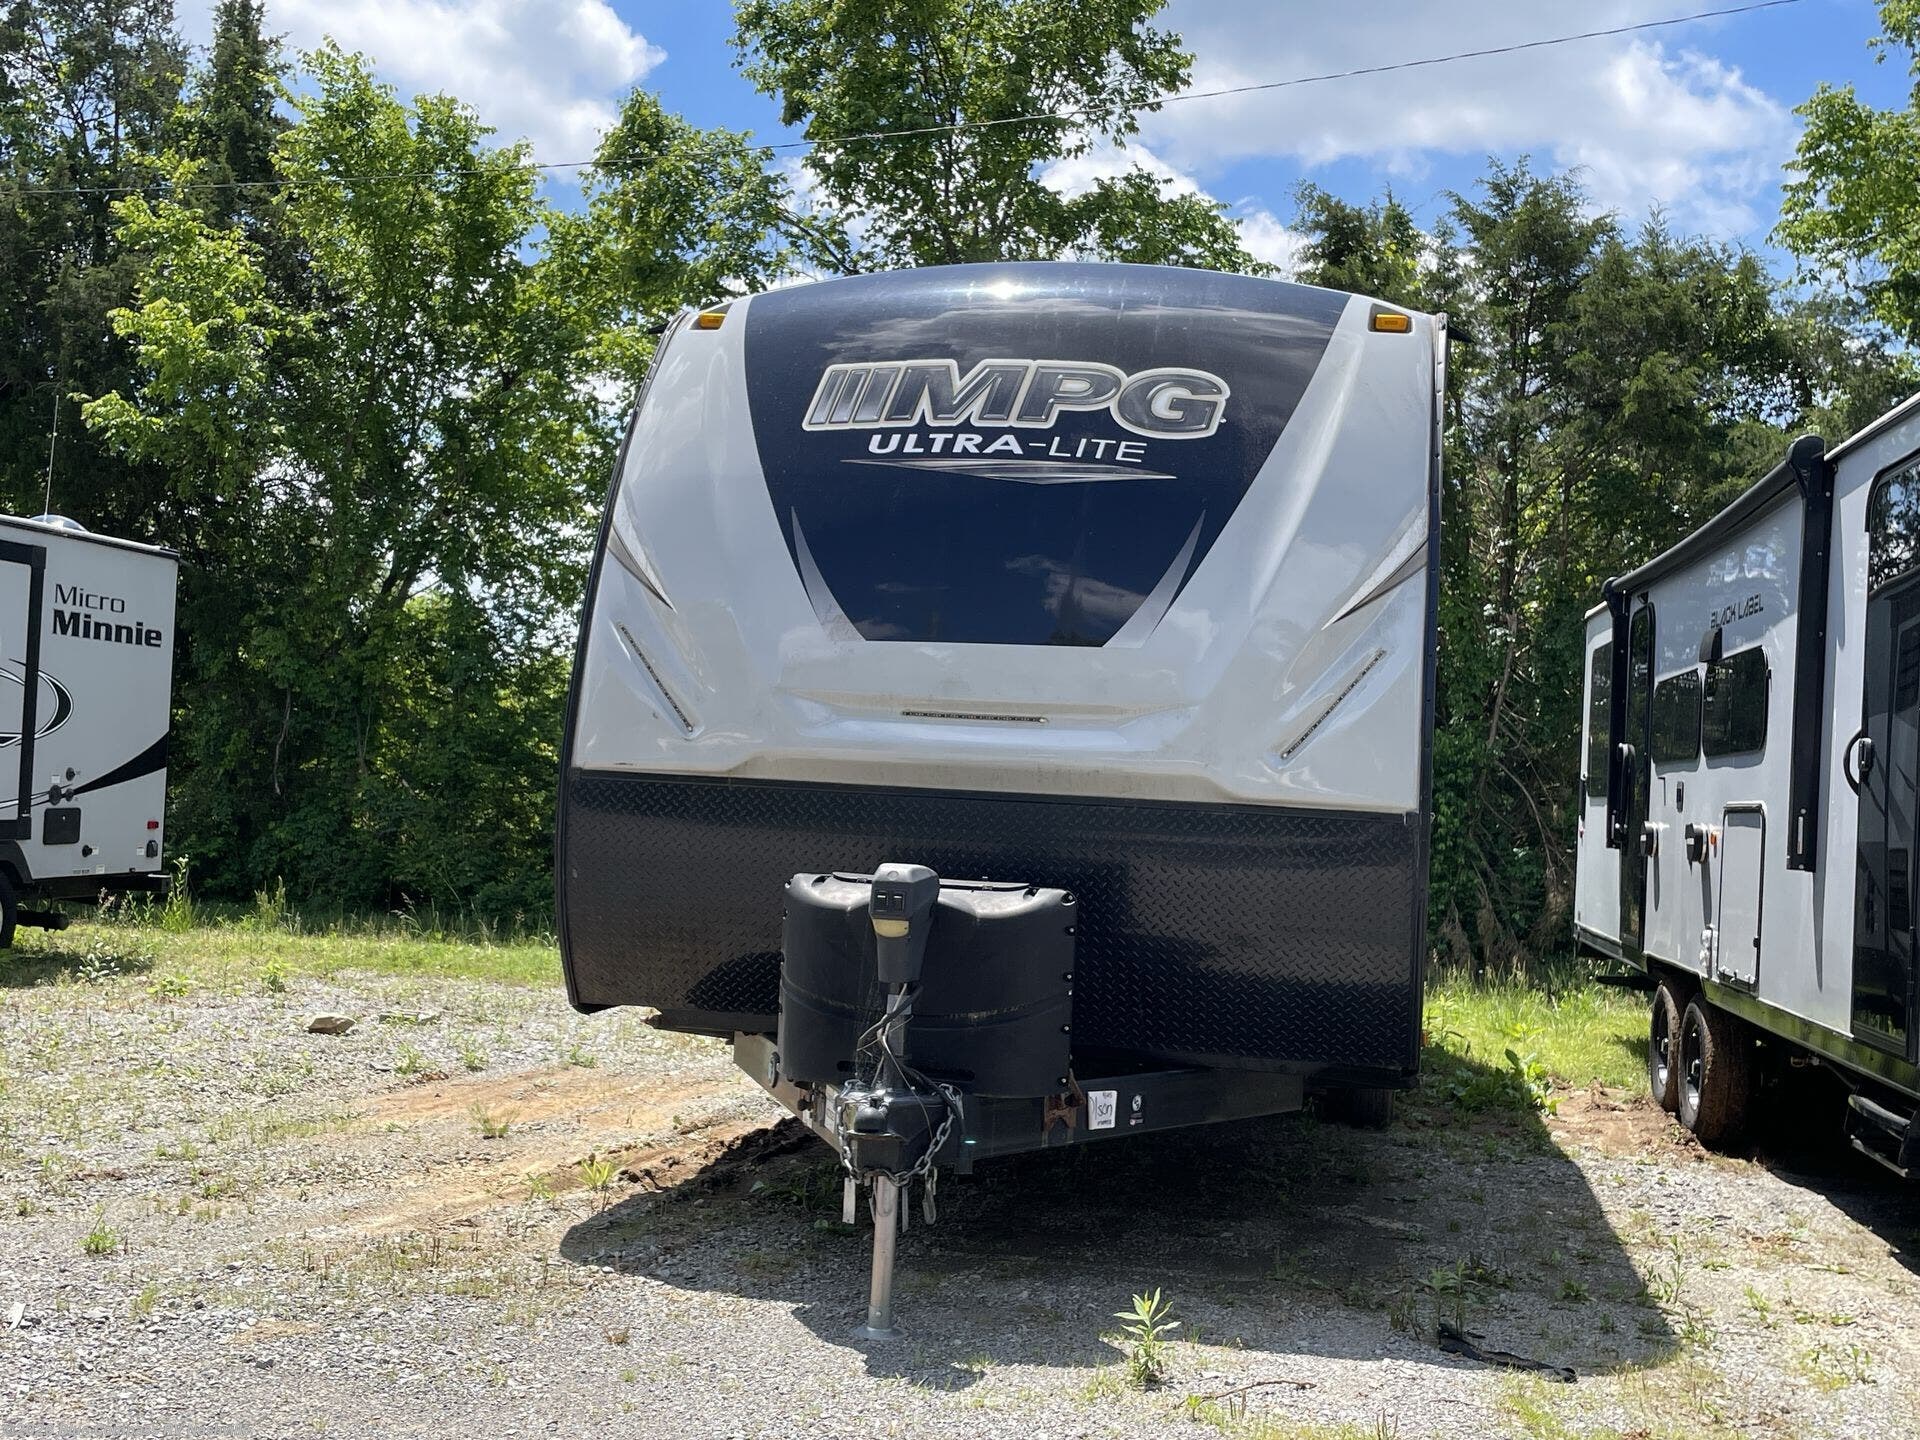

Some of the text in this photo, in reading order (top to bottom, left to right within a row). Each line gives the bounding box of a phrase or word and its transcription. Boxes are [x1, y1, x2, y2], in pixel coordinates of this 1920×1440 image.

[885, 358, 1230, 439] MPG
[867, 433, 1147, 463] ULTRA-LITE
[55, 583, 126, 613] Micro
[1711, 593, 1764, 629] BLACK LABEL
[52, 609, 162, 648] Minnie
